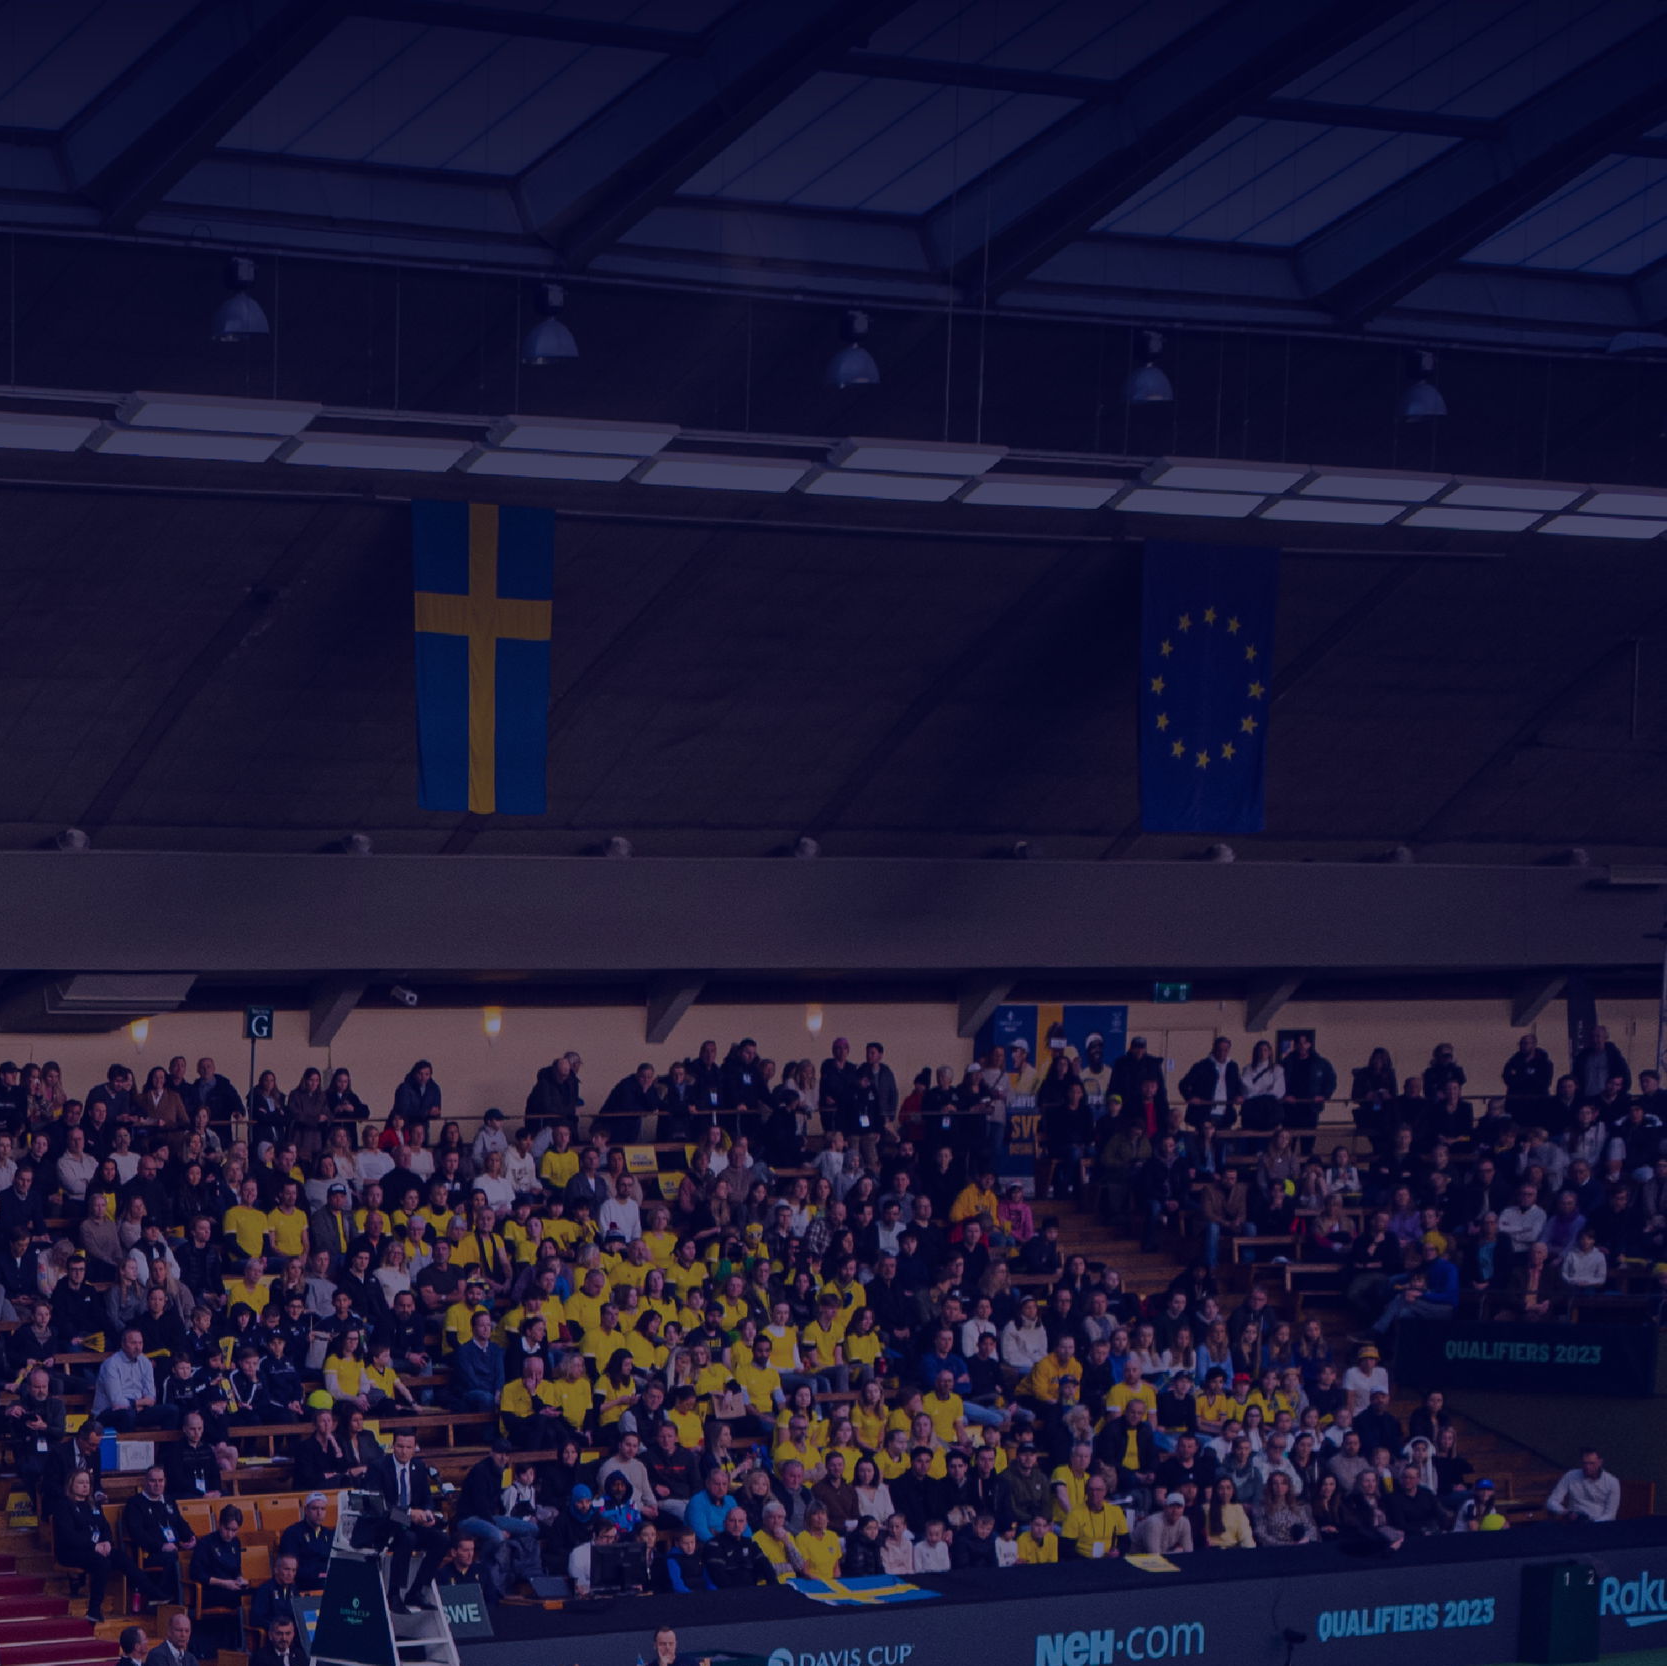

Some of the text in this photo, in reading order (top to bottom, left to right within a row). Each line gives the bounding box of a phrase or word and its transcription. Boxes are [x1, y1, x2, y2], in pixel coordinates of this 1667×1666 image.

[251, 1015, 268, 1037] G
[1445, 1340, 1603, 1365] QUALIFIERS 2023
[443, 1602, 482, 1625] SWE
[1317, 1597, 1496, 1642] QUALIFIERS 2023
